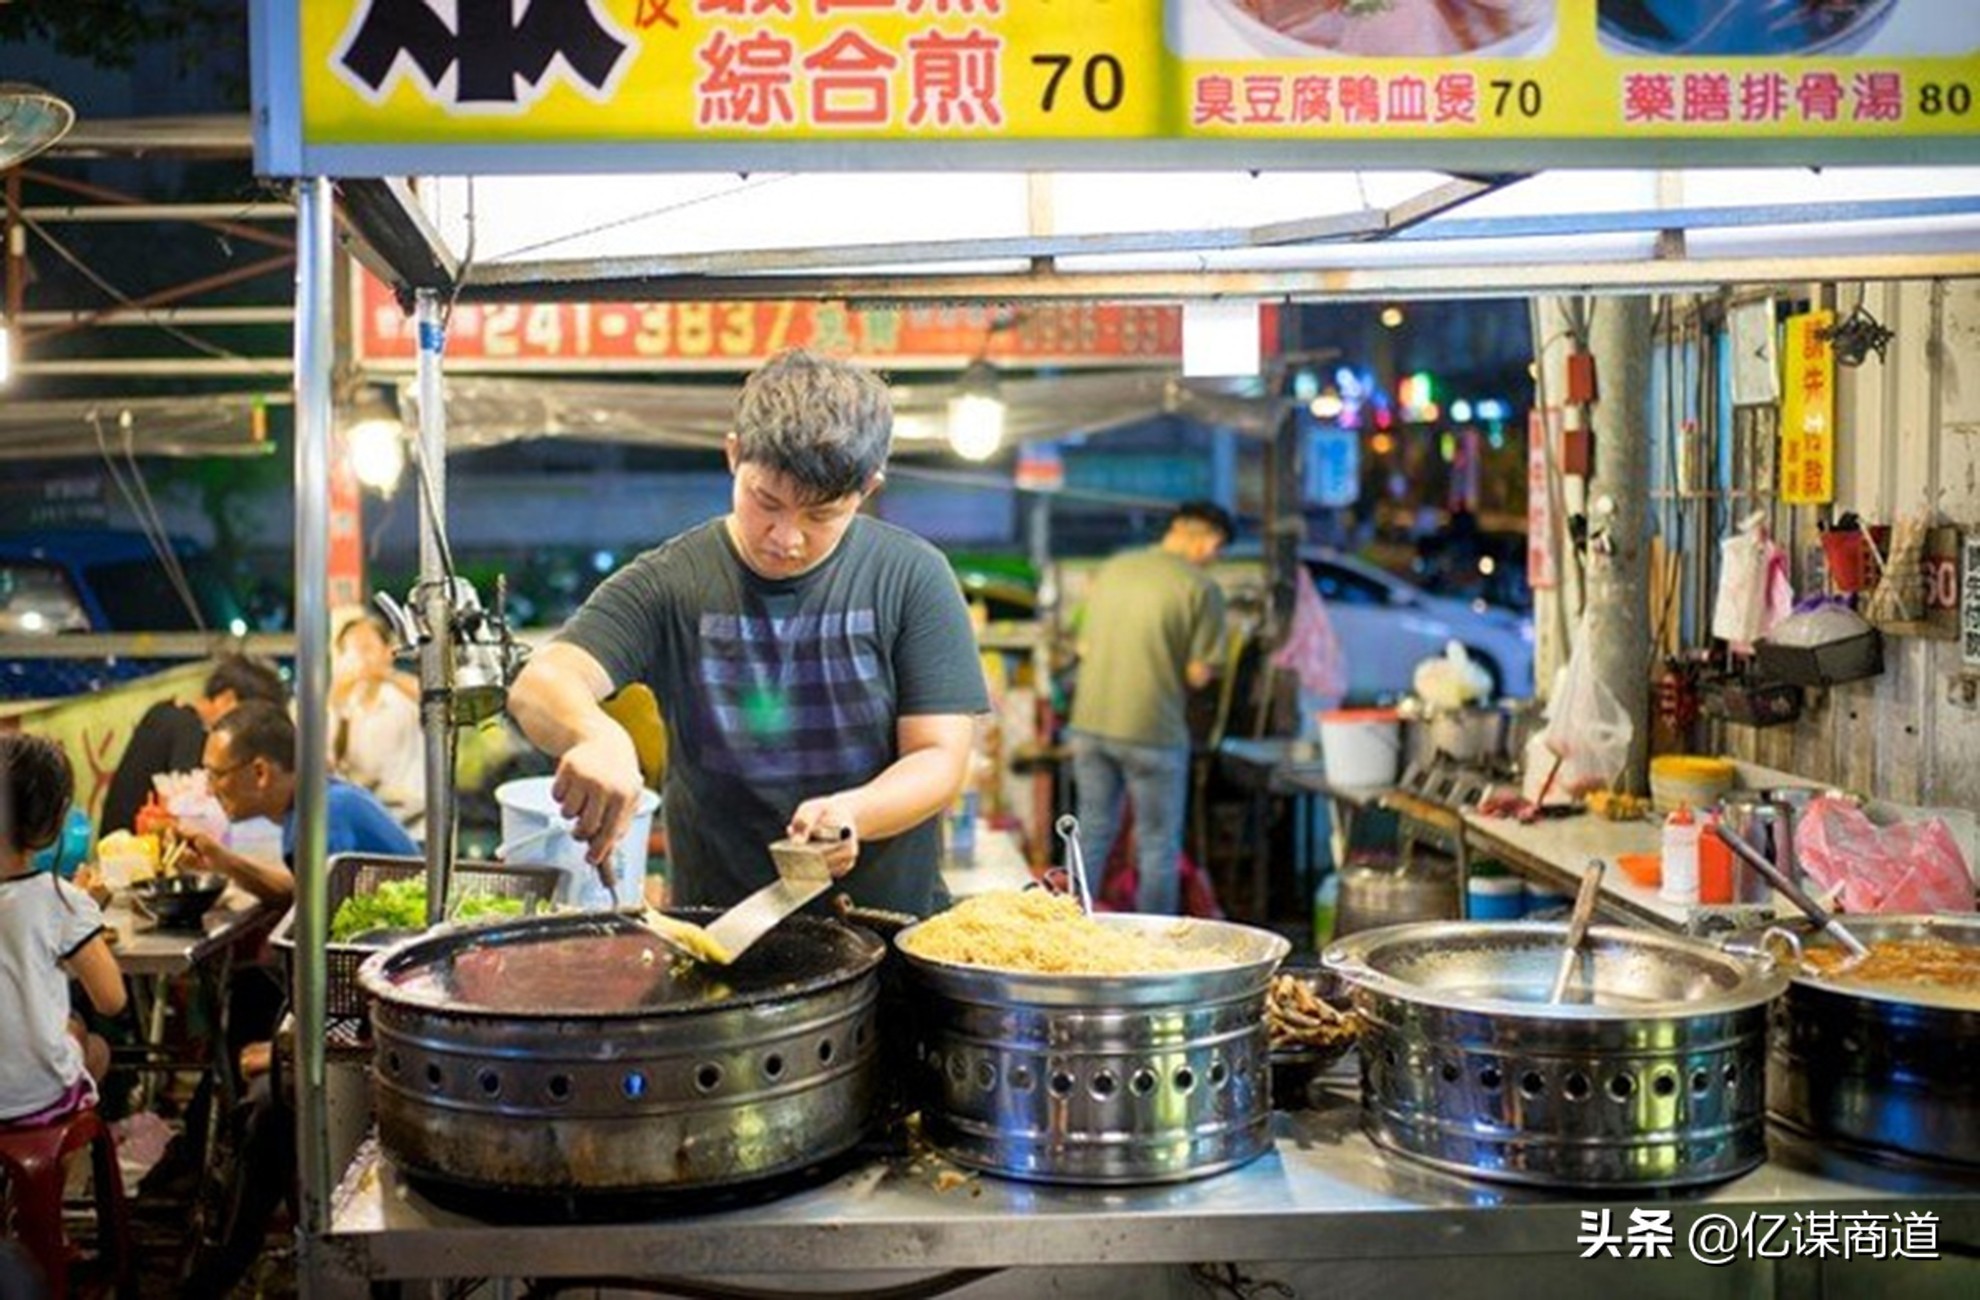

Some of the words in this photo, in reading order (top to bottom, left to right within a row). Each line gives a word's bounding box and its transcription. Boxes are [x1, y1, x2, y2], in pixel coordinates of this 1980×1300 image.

[699, 30, 1002, 126] 綜合煎
[1031, 53, 1125, 113] 70
[1194, 73, 1477, 124] 臭豆腐鴨血煲
[1489, 80, 1543, 118] 70
[1624, 72, 1902, 122] 藥膳排骨湯
[1918, 82, 1972, 116] 80
